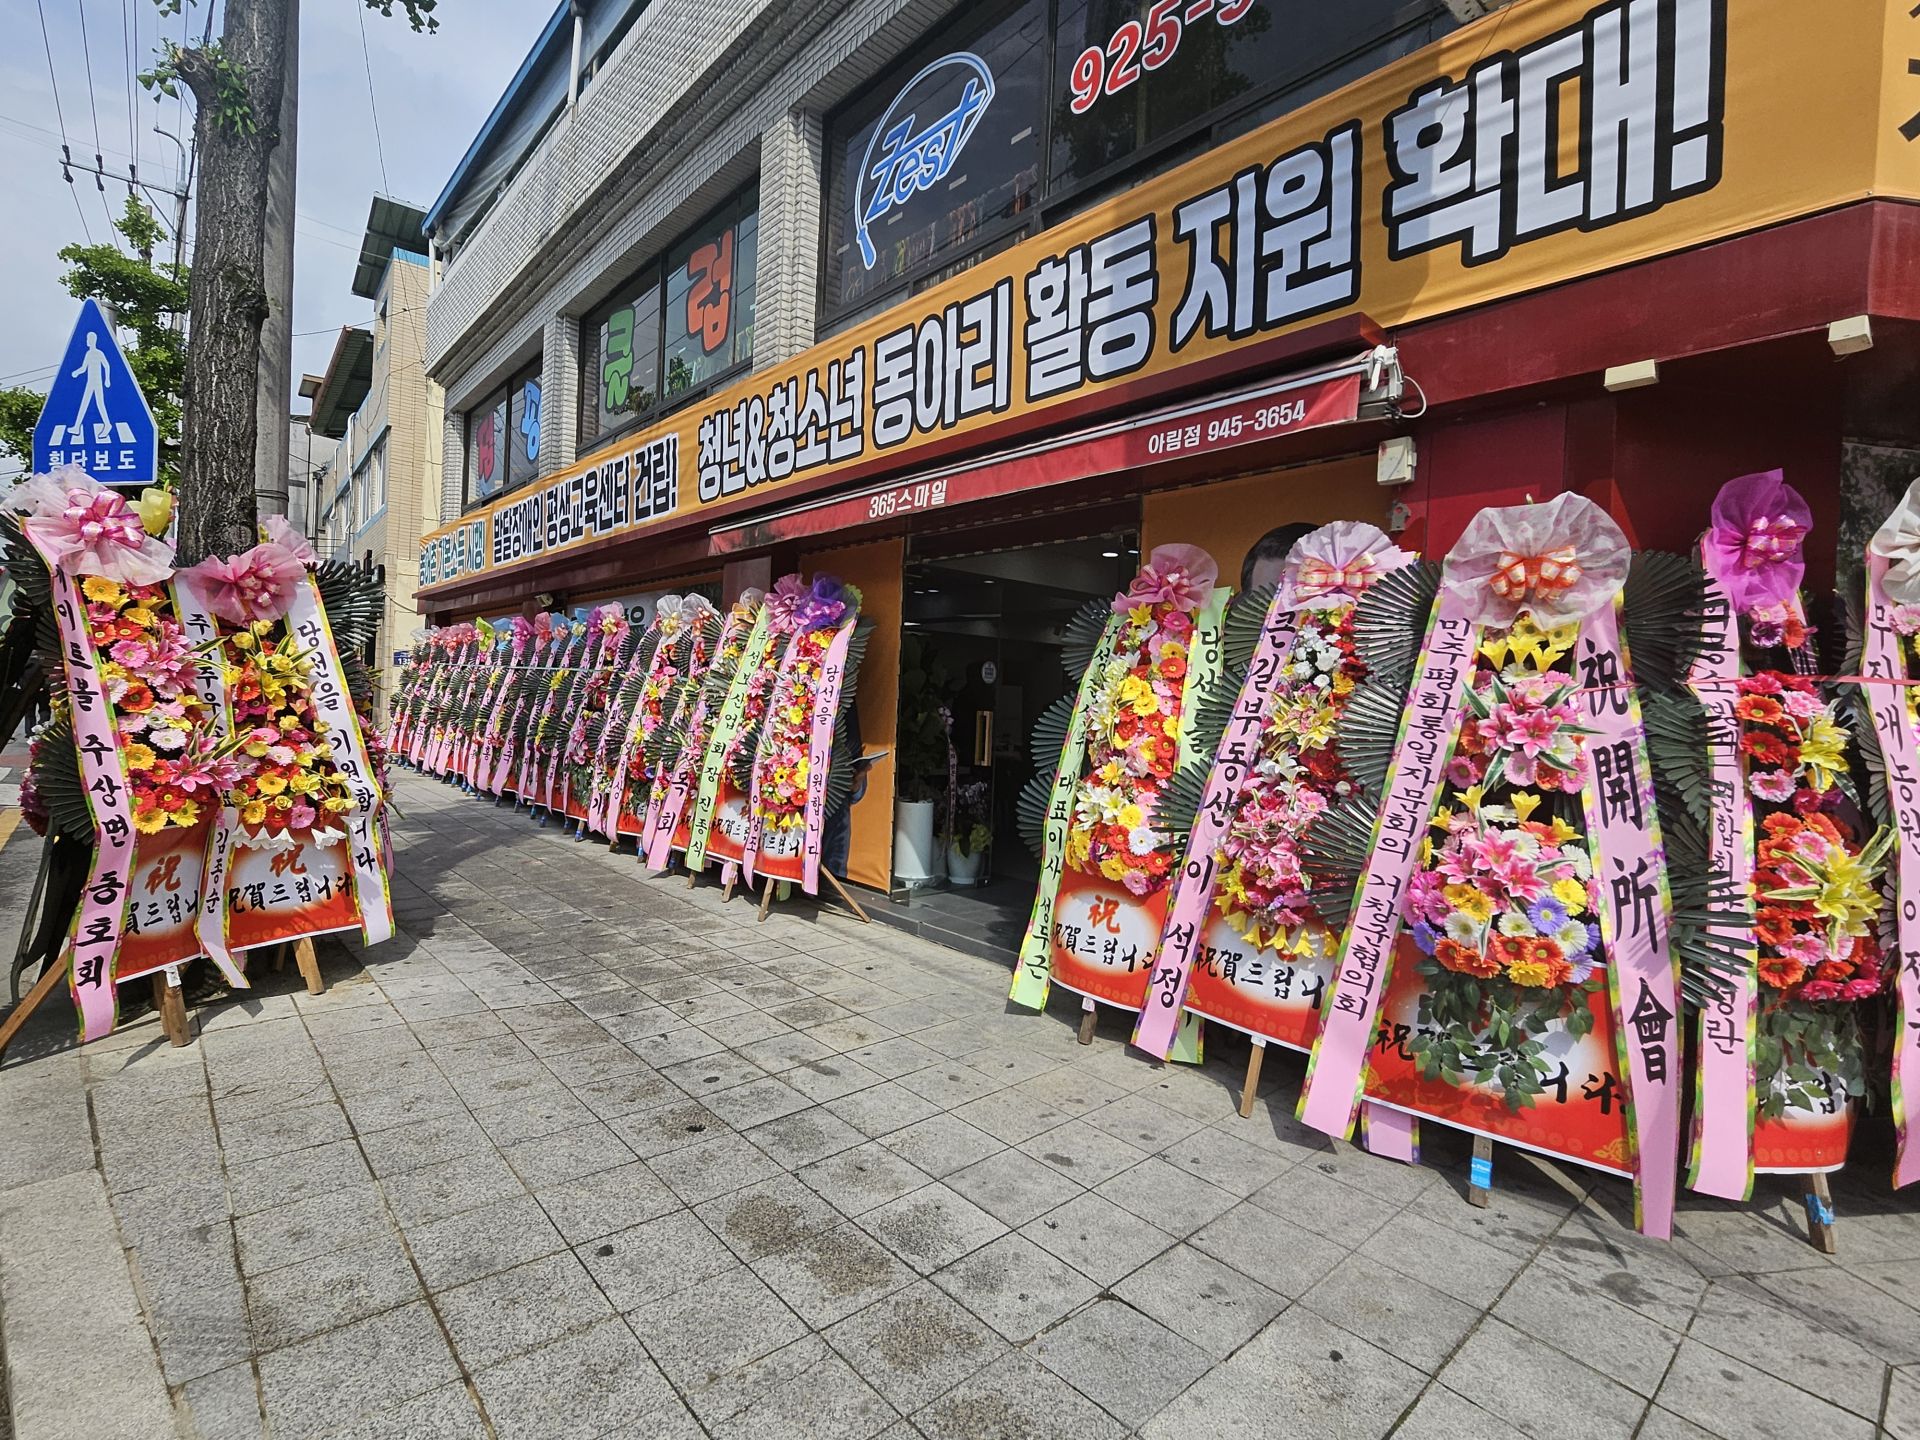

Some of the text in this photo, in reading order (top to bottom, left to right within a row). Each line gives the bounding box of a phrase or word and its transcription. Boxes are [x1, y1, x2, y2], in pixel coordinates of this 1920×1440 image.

[864, 77, 987, 224] Zest
[699, 346, 864, 502] 청년&청소년
[873, 277, 1013, 449] 동아리
[1026, 214, 1158, 401] 활동
[1170, 118, 1362, 352] 지원
[1383, 0, 1727, 267] 확대!
[49, 449, 136, 472] 횡단보도
[1148, 400, 1306, 454] 아림점 945-3654
[493, 432, 679, 566] 발달장애인 평생교육센터 건립!
[869, 480, 947, 518] 365스마일
[297, 620, 376, 876] 당선을 기원합니다
[1204, 609, 1297, 828] 큰길부동산
[80, 733, 129, 848] 주상면
[704, 741, 726, 783] 회장
[807, 664, 840, 861] 당선을 기원합니다
[269, 843, 307, 877] 祝
[691, 796, 712, 858] 진종식
[1044, 771, 1075, 880] 대표이사
[1333, 616, 1471, 1022] 민주평화통일자문회의 거창군협의회
[144, 854, 182, 895] 祝
[205, 828, 230, 914] 김종순
[1087, 894, 1121, 934] 祝
[76, 870, 126, 990] 동호회
[1026, 897, 1050, 979] 성두근
[1195, 943, 1325, 1010] 祝賀드립니
